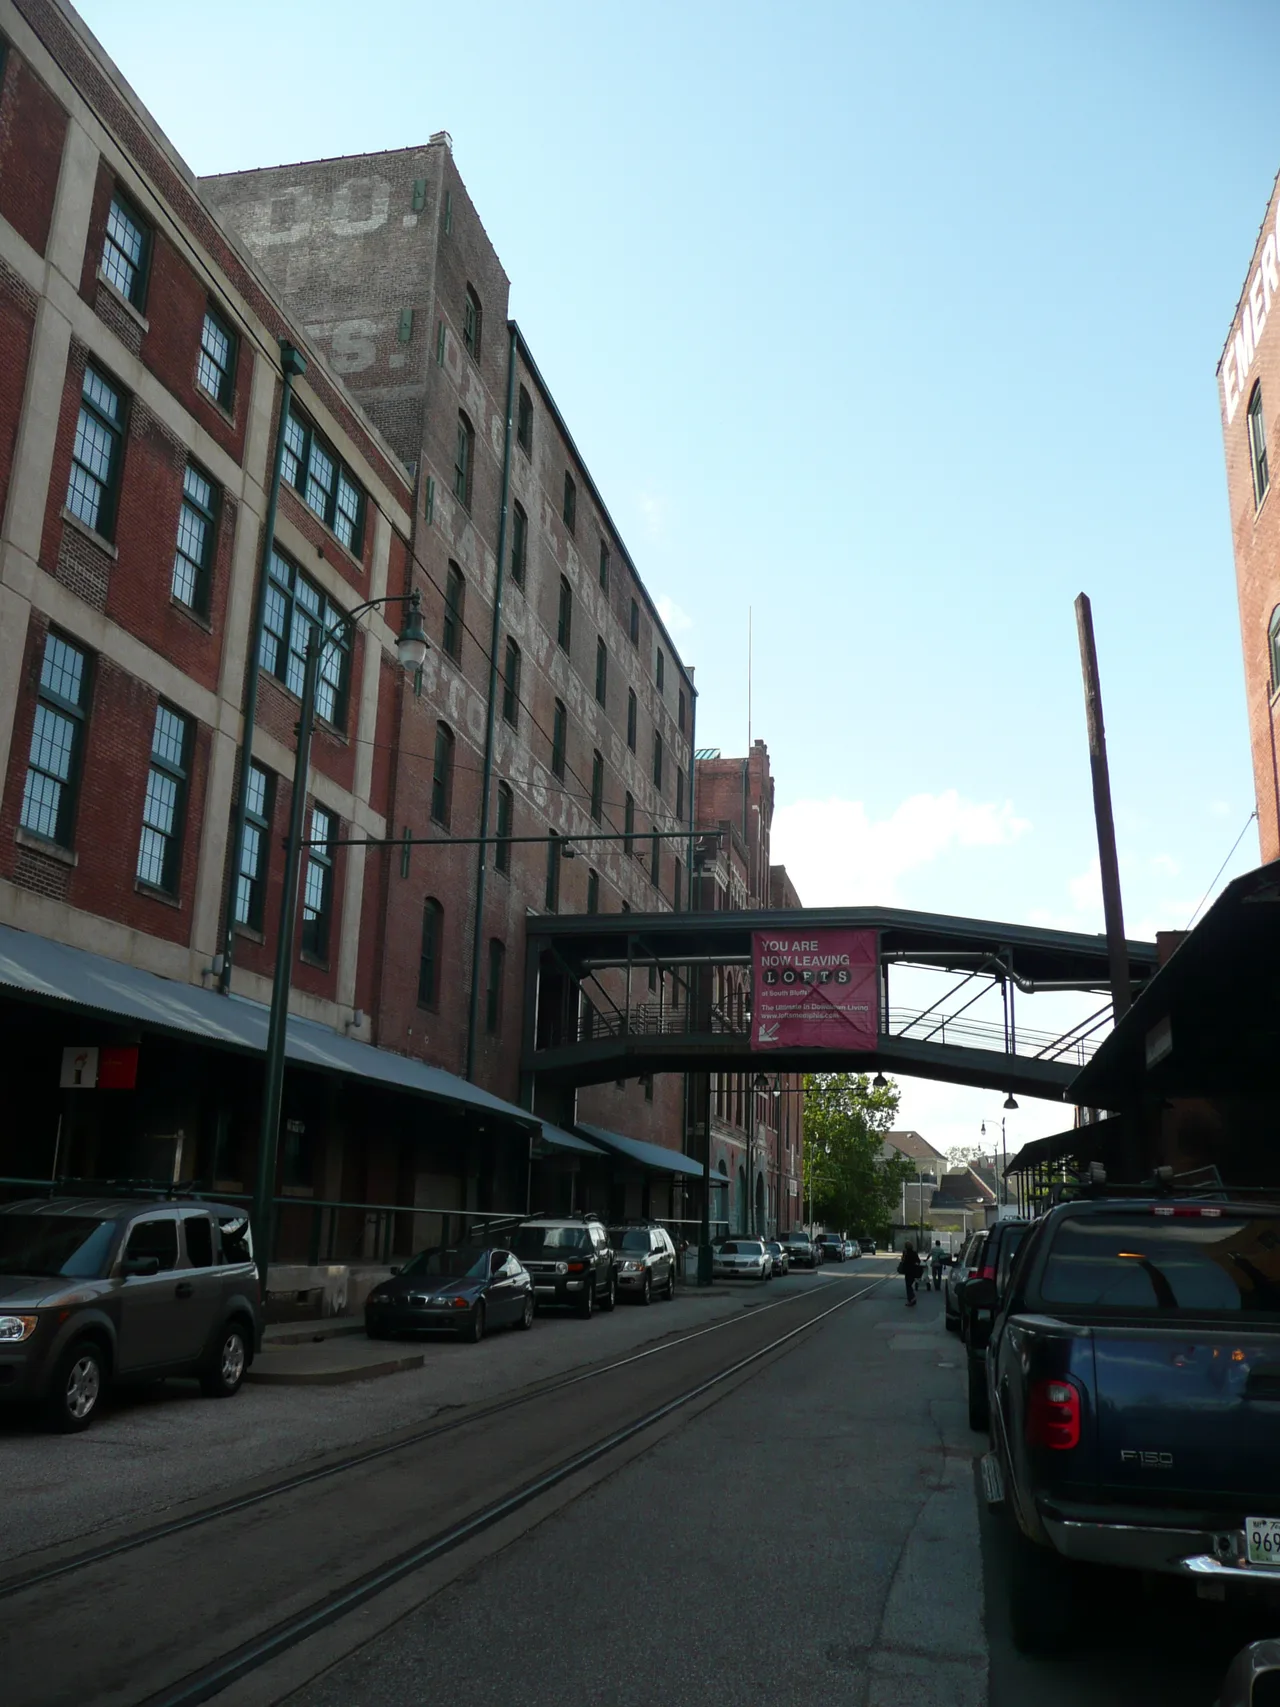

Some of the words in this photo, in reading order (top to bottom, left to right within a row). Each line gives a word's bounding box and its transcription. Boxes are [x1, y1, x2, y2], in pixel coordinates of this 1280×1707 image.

[1222, 198, 1280, 425] EMER
[762, 941, 788, 951] YOU
[792, 941, 818, 951] ARE
[762, 956, 791, 966] NOW
[795, 955, 850, 966] LEAVING
[766, 971, 848, 983] LOFTS
[847, 1004, 869, 1012] Living
